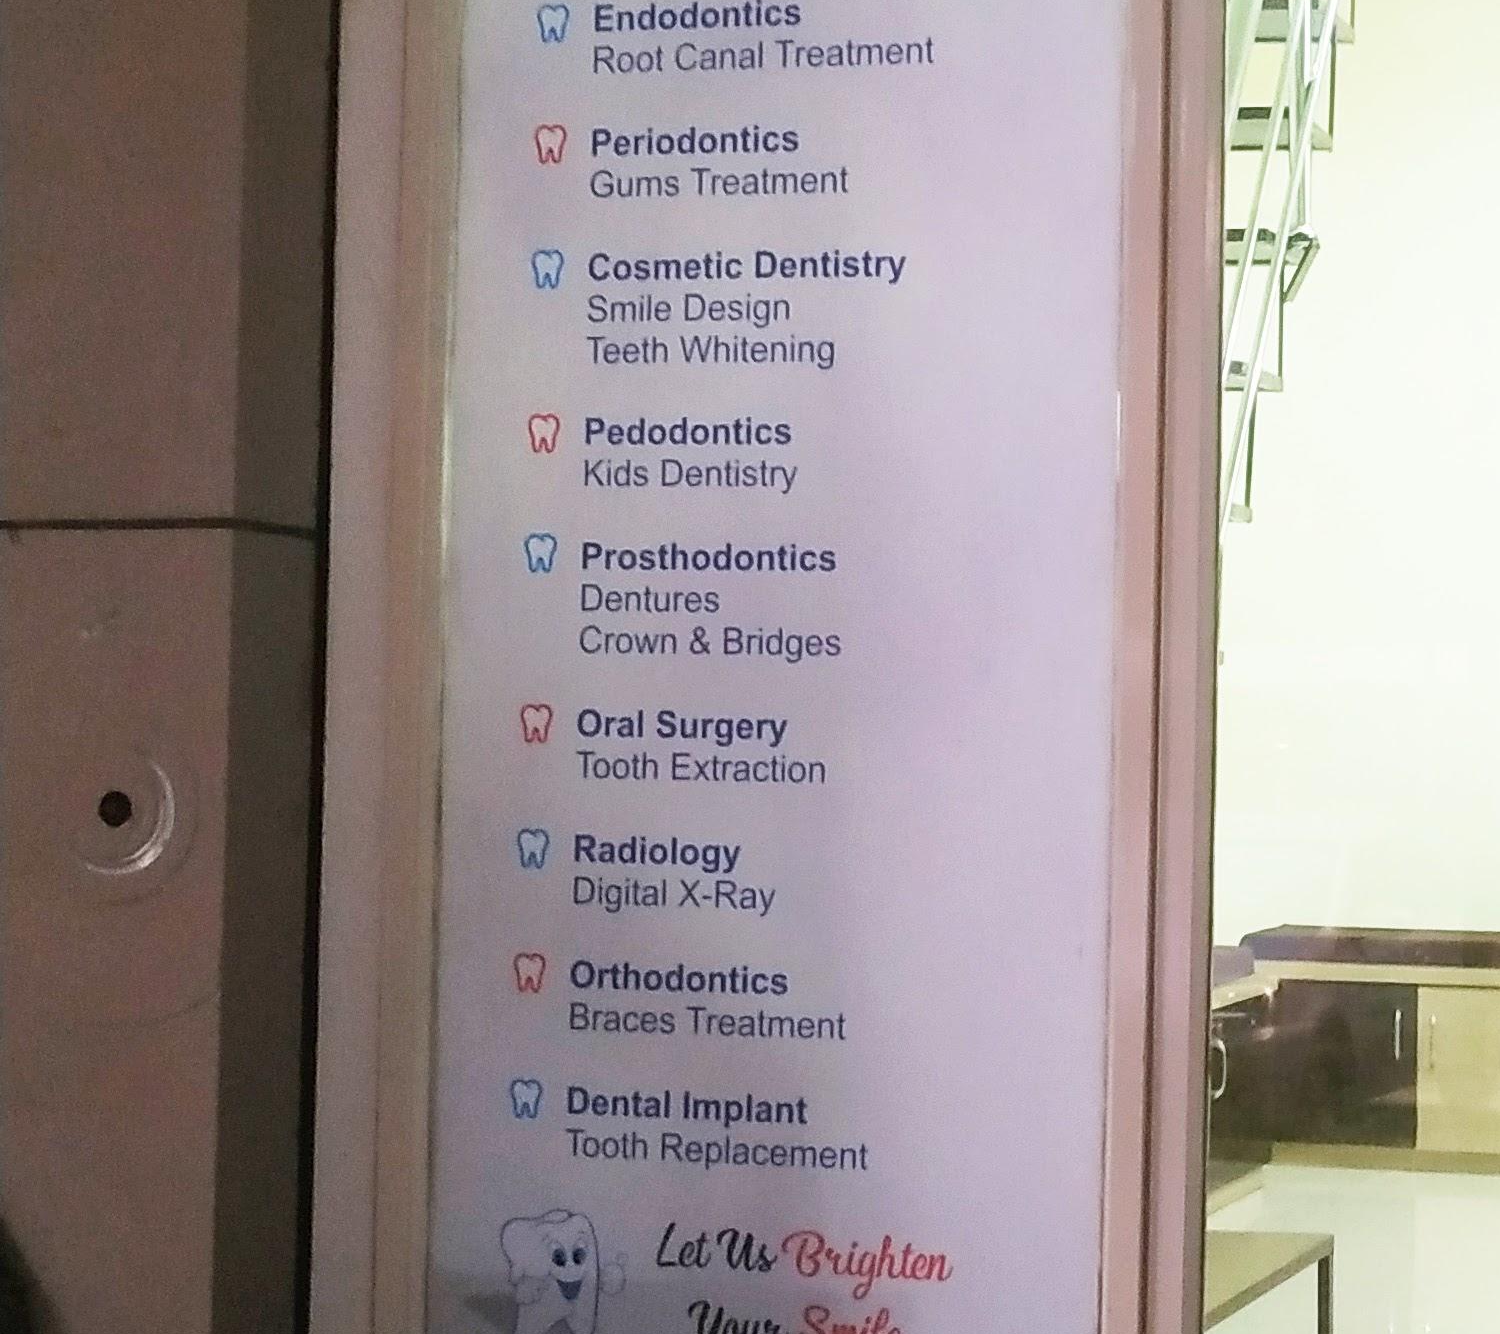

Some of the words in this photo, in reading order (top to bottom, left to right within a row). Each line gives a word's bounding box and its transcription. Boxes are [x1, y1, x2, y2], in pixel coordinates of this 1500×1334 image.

[595, 0, 800, 32] Endodontics
[594, 46, 663, 73] Root
[675, 41, 763, 71] Canal
[777, 37, 934, 68] Treatment
[592, 125, 798, 157] Periodontics
[590, 170, 679, 198] Gums
[693, 167, 848, 196] Treatment
[589, 252, 741, 281] Cosmetic
[755, 250, 905, 283] Dentistry
[588, 294, 671, 323] Smile
[684, 293, 790, 328] Design
[587, 336, 668, 364] Teeth
[680, 335, 834, 370] Whitening
[585, 417, 791, 445] Pedodontics
[584, 460, 648, 487] Kids
[661, 459, 797, 494] Dentistry
[582, 542, 835, 571] Prosthodontics
[581, 584, 719, 613] Dentures
[580, 625, 677, 654] Crown
[690, 626, 710, 654] &
[724, 627, 841, 663] Bridges
[577, 709, 643, 737] Oral
[657, 710, 787, 747] Surgery
[576, 751, 658, 780] Tooth
[672, 752, 825, 783] Extraction
[574, 835, 740, 873] Radiology
[573, 876, 666, 913] Digital
[678, 880, 775, 917] X-Ray
[570, 960, 788, 995] Orthodontics
[570, 1002, 675, 1034] Braces
[686, 1007, 846, 1040] Treatment
[568, 1086, 670, 1118] Dental
[684, 1091, 806, 1128] Implant
[566, 1128, 648, 1159] Tooth
[661, 1133, 867, 1169] Replacement
[656, 1222, 711, 1268] Let
[717, 1227, 778, 1273] Us
[782, 1230, 952, 1299] Brighten
